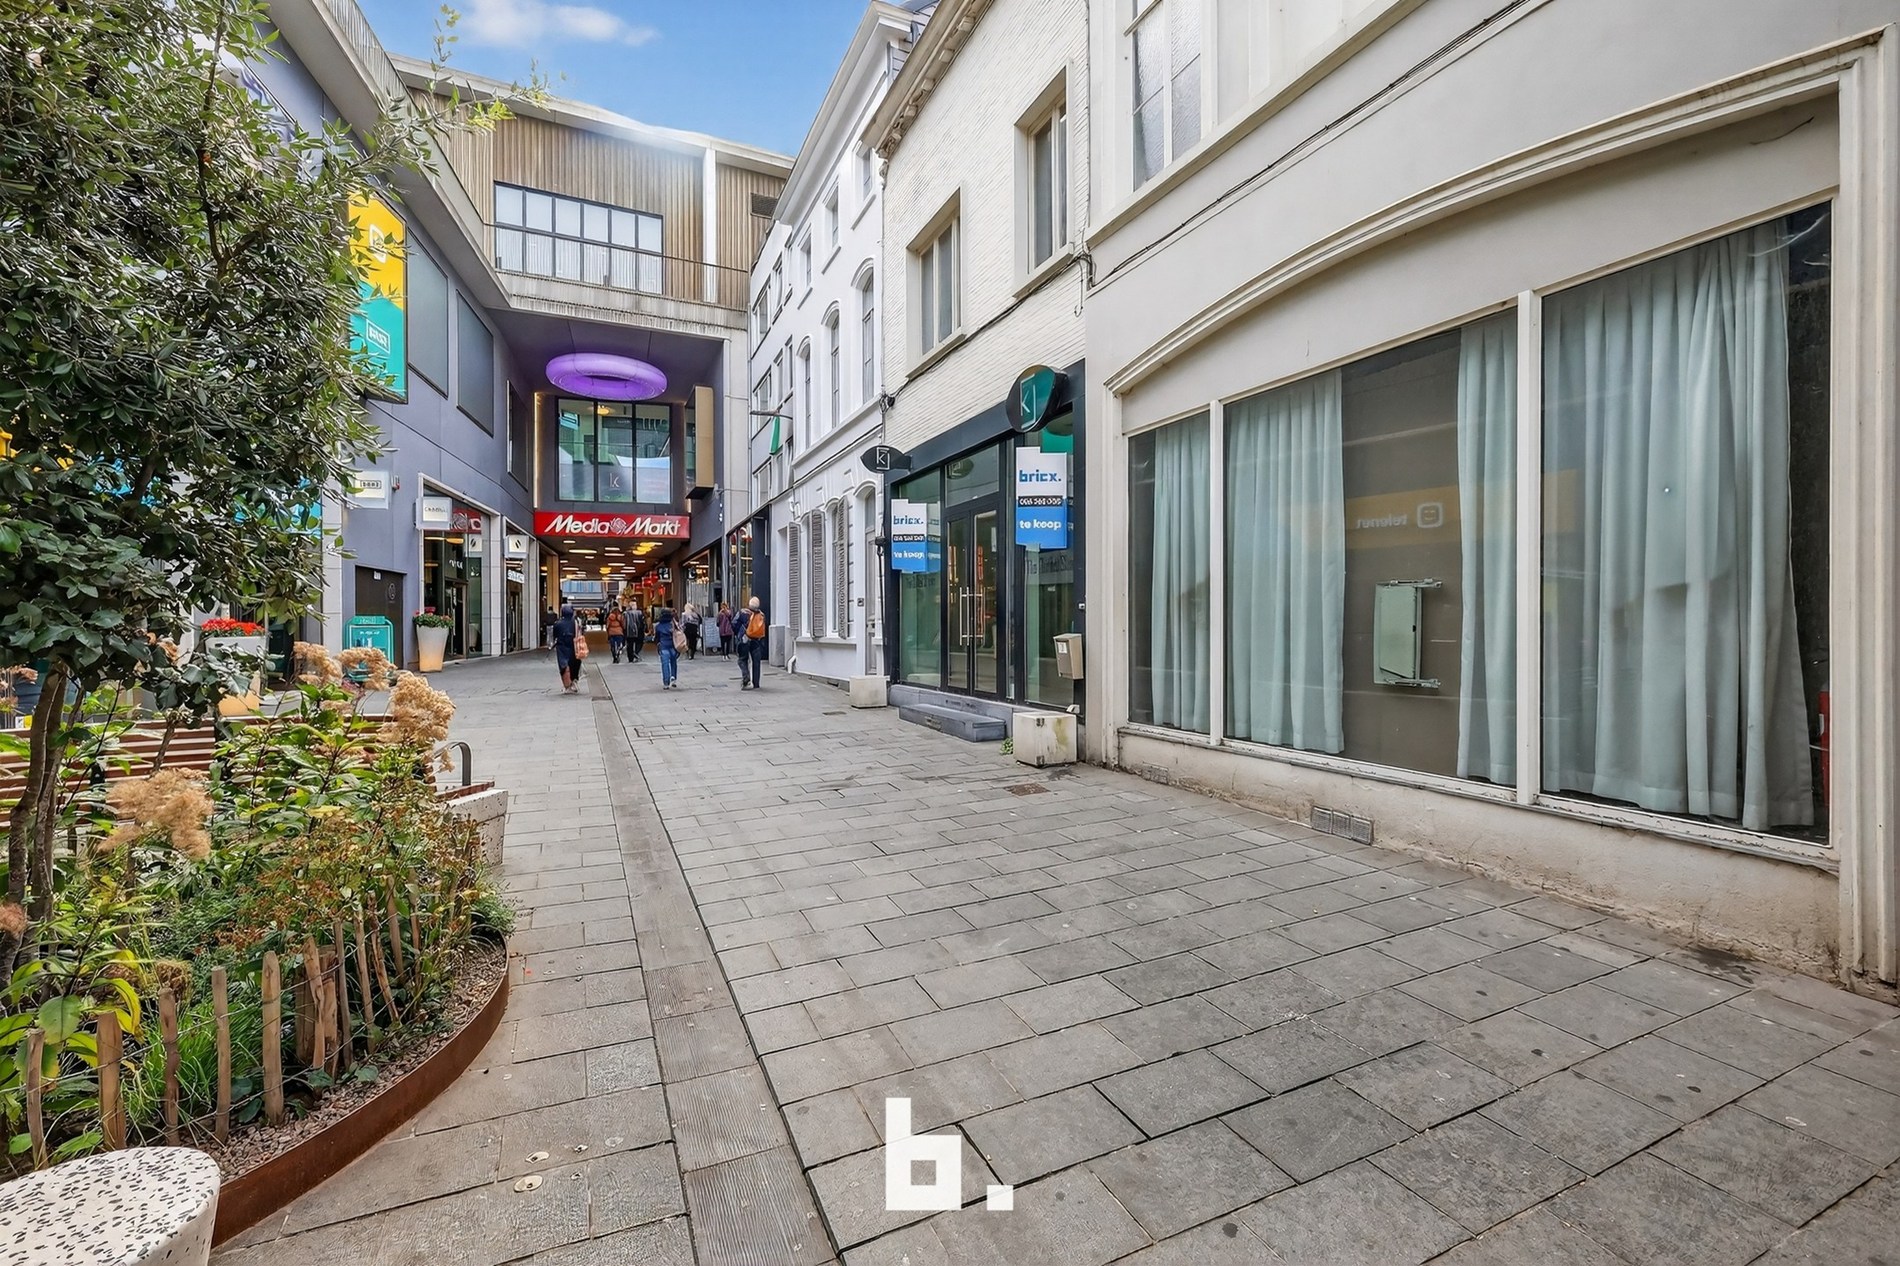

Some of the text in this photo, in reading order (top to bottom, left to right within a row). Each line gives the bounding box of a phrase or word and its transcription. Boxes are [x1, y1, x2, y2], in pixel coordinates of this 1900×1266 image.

[1019, 469, 1062, 482] bricx.
[544, 514, 680, 536] Media Markt
[893, 515, 924, 525] bricx.
[1020, 520, 1031, 529] te
[1033, 519, 1062, 531] koop
